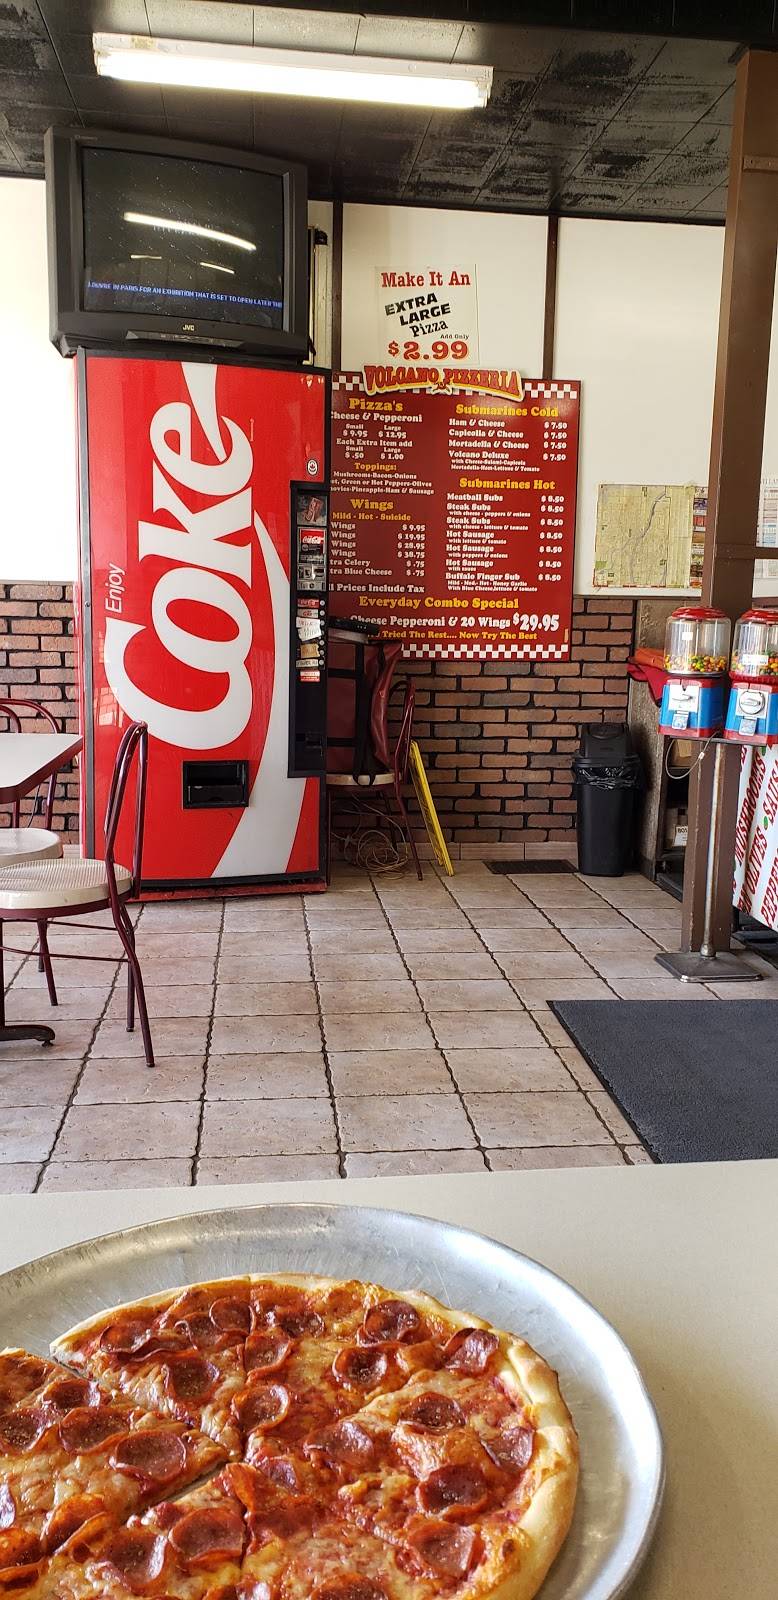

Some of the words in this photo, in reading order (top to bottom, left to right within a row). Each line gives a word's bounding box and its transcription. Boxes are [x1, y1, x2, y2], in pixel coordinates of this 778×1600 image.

[381, 272, 424, 287] Make
[429, 272, 443, 286] It
[448, 271, 470, 286] An
[385, 293, 438, 315] EXTRA
[399, 303, 451, 325] LARGE
[409, 321, 448, 338] Pizza
[364, 365, 439, 391] VOLCANO
[443, 368, 520, 397] PIZZERIA
[349, 398, 403, 411] Pizza's
[456, 404, 528, 416] Submarines
[531, 406, 558, 417] Cold
[373, 413, 422, 423] Pepperoni
[448, 440, 491, 448] Mortadella
[355, 463, 396, 471] Toppings:
[460, 478, 530, 489] Submarines
[533, 480, 555, 489] Hot
[447, 493, 481, 501] Meatball
[484, 494, 503, 502] Subs
[351, 499, 394, 511] Wings
[472, 503, 491, 511] Subs
[333, 512, 351, 520] Mild
[332, 540, 356, 548] Wings
[463, 559, 493, 567] Sausage
[103, 400, 254, 750] Coke
[477, 573, 503, 581] Finger
[105, 562, 125, 613] Enjoy
[368, 584, 405, 592] Include
[359, 596, 421, 609] Everyday
[424, 597, 468, 609] Combo
[472, 598, 519, 610] Special
[390, 616, 445, 627] Pepperoni
[448, 617, 458, 627] &
[461, 617, 475, 627] 20
[478, 617, 510, 631] Wings
[513, 612, 559, 631] $29.95
[482, 632, 497, 640] Try
[519, 632, 537, 640] Best
[735, 748, 766, 867] MUSHROOMS
[746, 826, 767, 894] OLIVES
